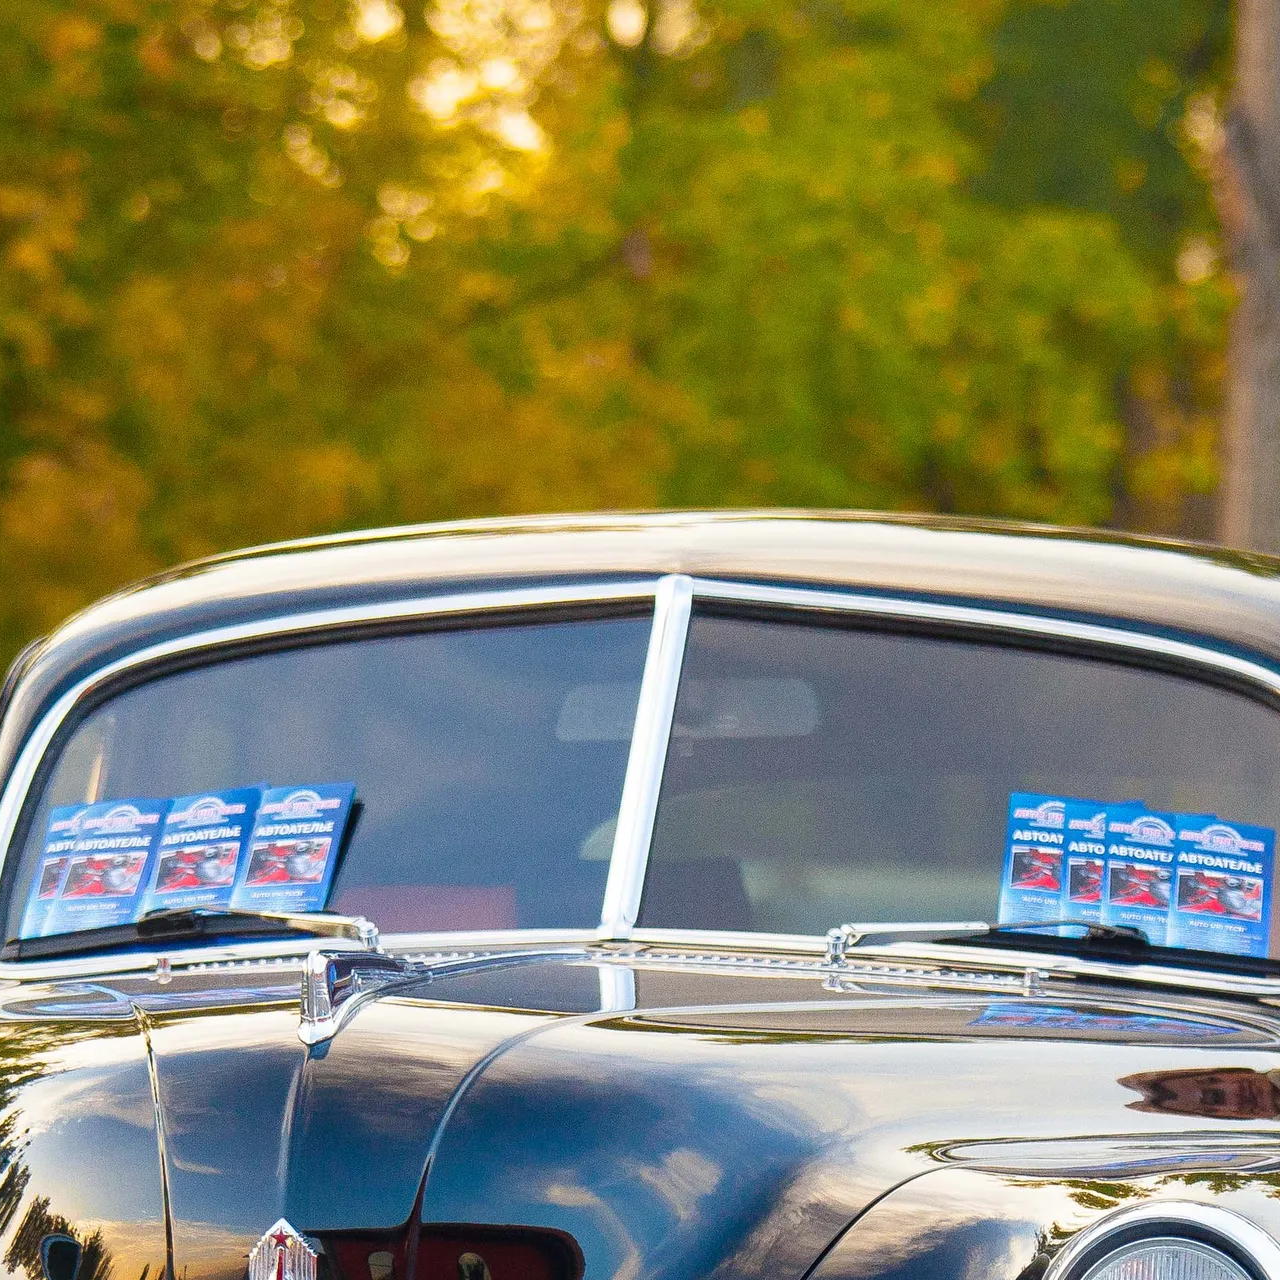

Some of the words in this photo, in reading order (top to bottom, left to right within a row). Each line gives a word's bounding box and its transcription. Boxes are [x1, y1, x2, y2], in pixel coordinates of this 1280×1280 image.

[163, 824, 242, 846] АВТОАТЕЛЬЕ
[256, 821, 335, 837] АВТОАТЕЛЬЕ
[76, 835, 153, 851] АВТОАТЕЛЬЕ
[1178, 851, 1264, 874] АВТОАТЕЛЬЕ
